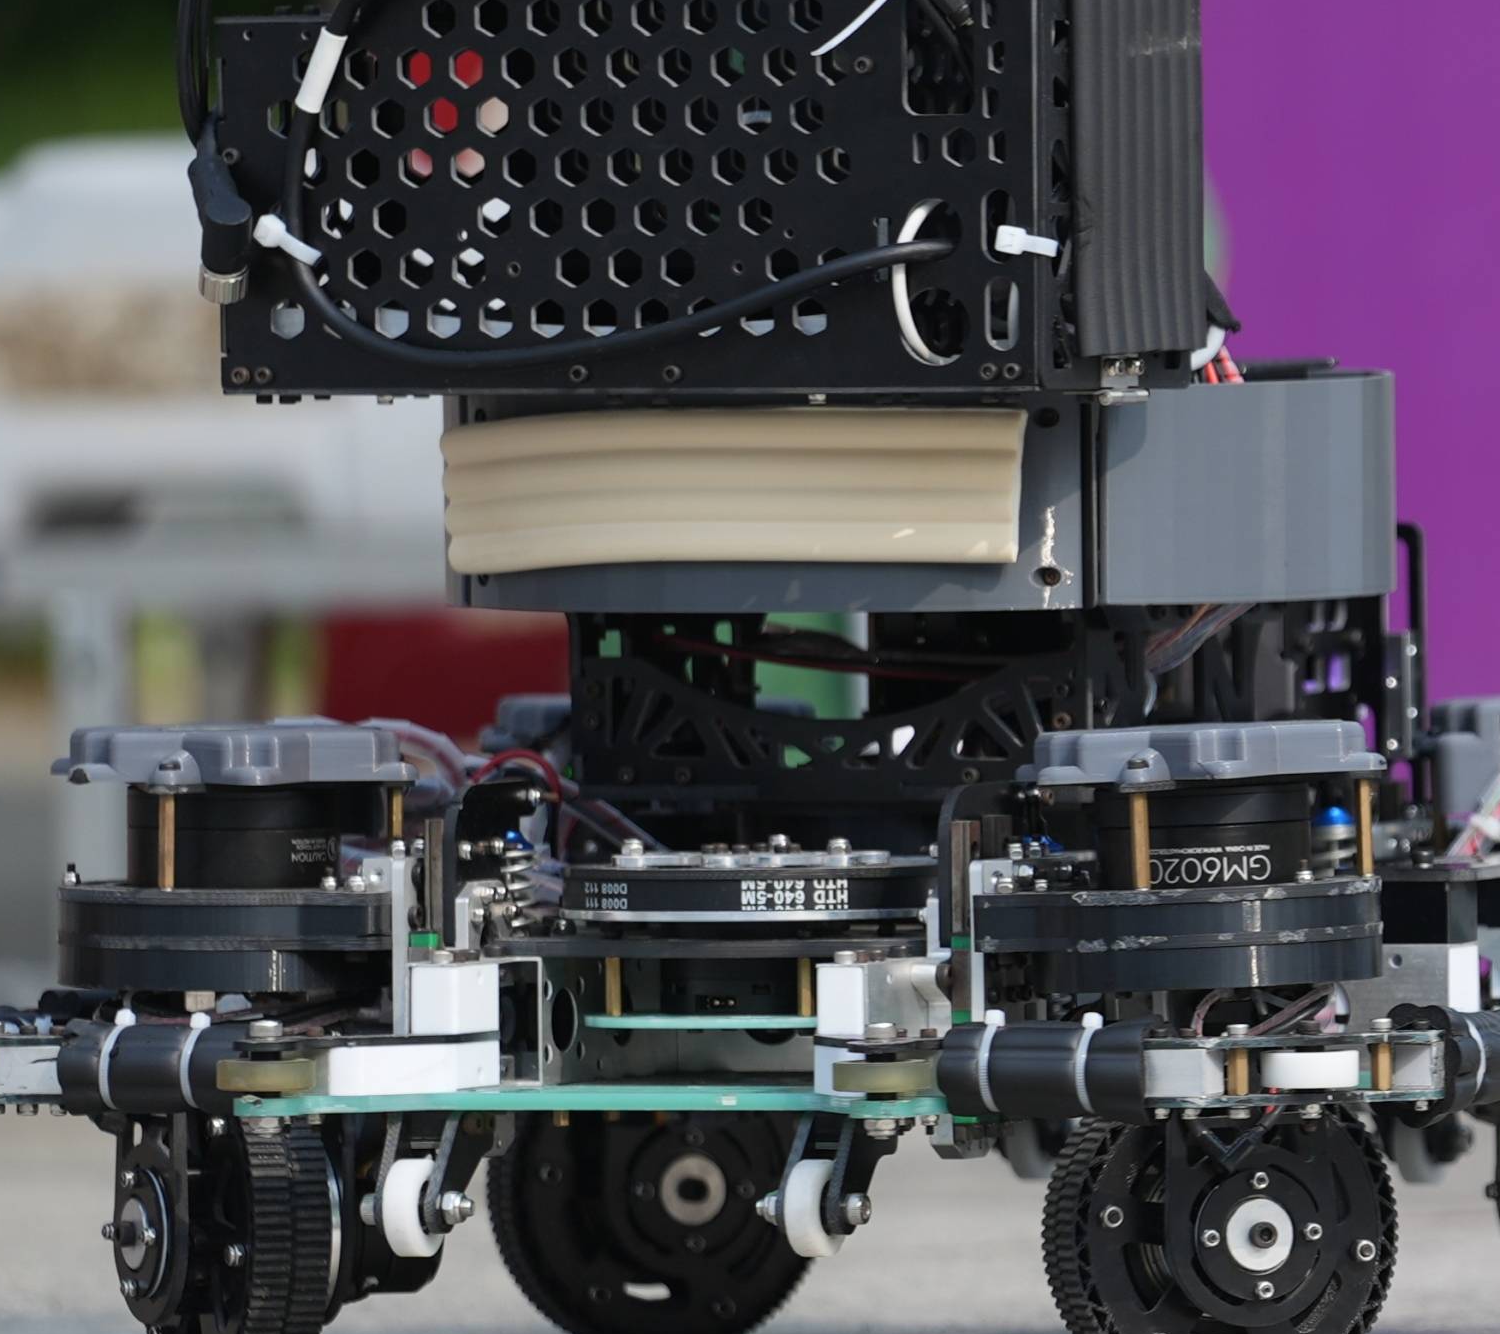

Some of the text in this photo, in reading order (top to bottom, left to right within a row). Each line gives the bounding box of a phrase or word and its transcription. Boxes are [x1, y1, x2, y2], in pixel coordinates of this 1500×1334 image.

[291, 852, 327, 862] CAUTION
[585, 897, 599, 909] 111
[741, 889, 849, 905] HTD 640-5M
